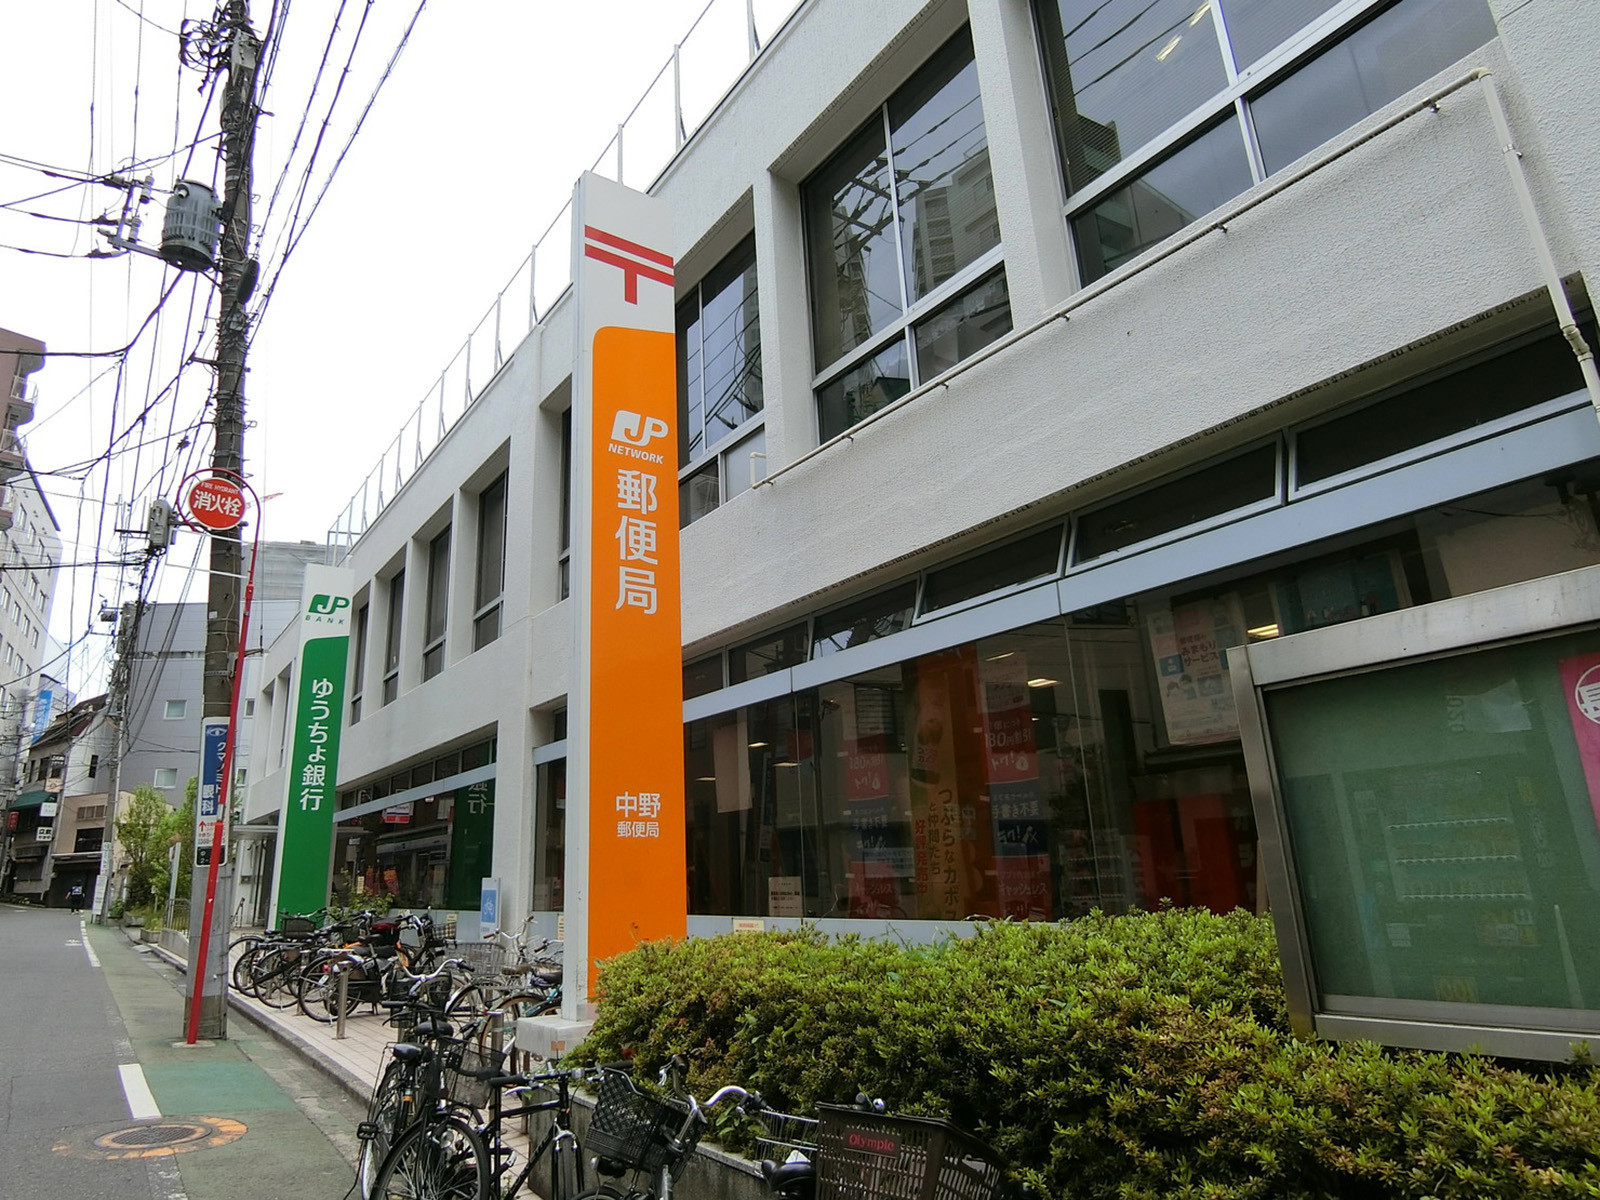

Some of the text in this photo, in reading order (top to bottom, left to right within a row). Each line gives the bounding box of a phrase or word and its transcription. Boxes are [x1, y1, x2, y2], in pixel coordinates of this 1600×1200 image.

[608, 443, 664, 465] NETWORK
[193, 489, 243, 518] 消火栓
[615, 468, 658, 615] 郵便局
[305, 614, 344, 625] BANK
[1182, 639, 1216, 656] みまもり
[1184, 651, 1218, 667] サービス
[300, 677, 334, 811] ゆうちょ銀行
[615, 791, 661, 818] 中野
[617, 821, 660, 838] 郵便局
[928, 801, 940, 875] と仲間たち
[915, 819, 928, 894] 好評発売中
[850, 1134, 894, 1151] Olympic
